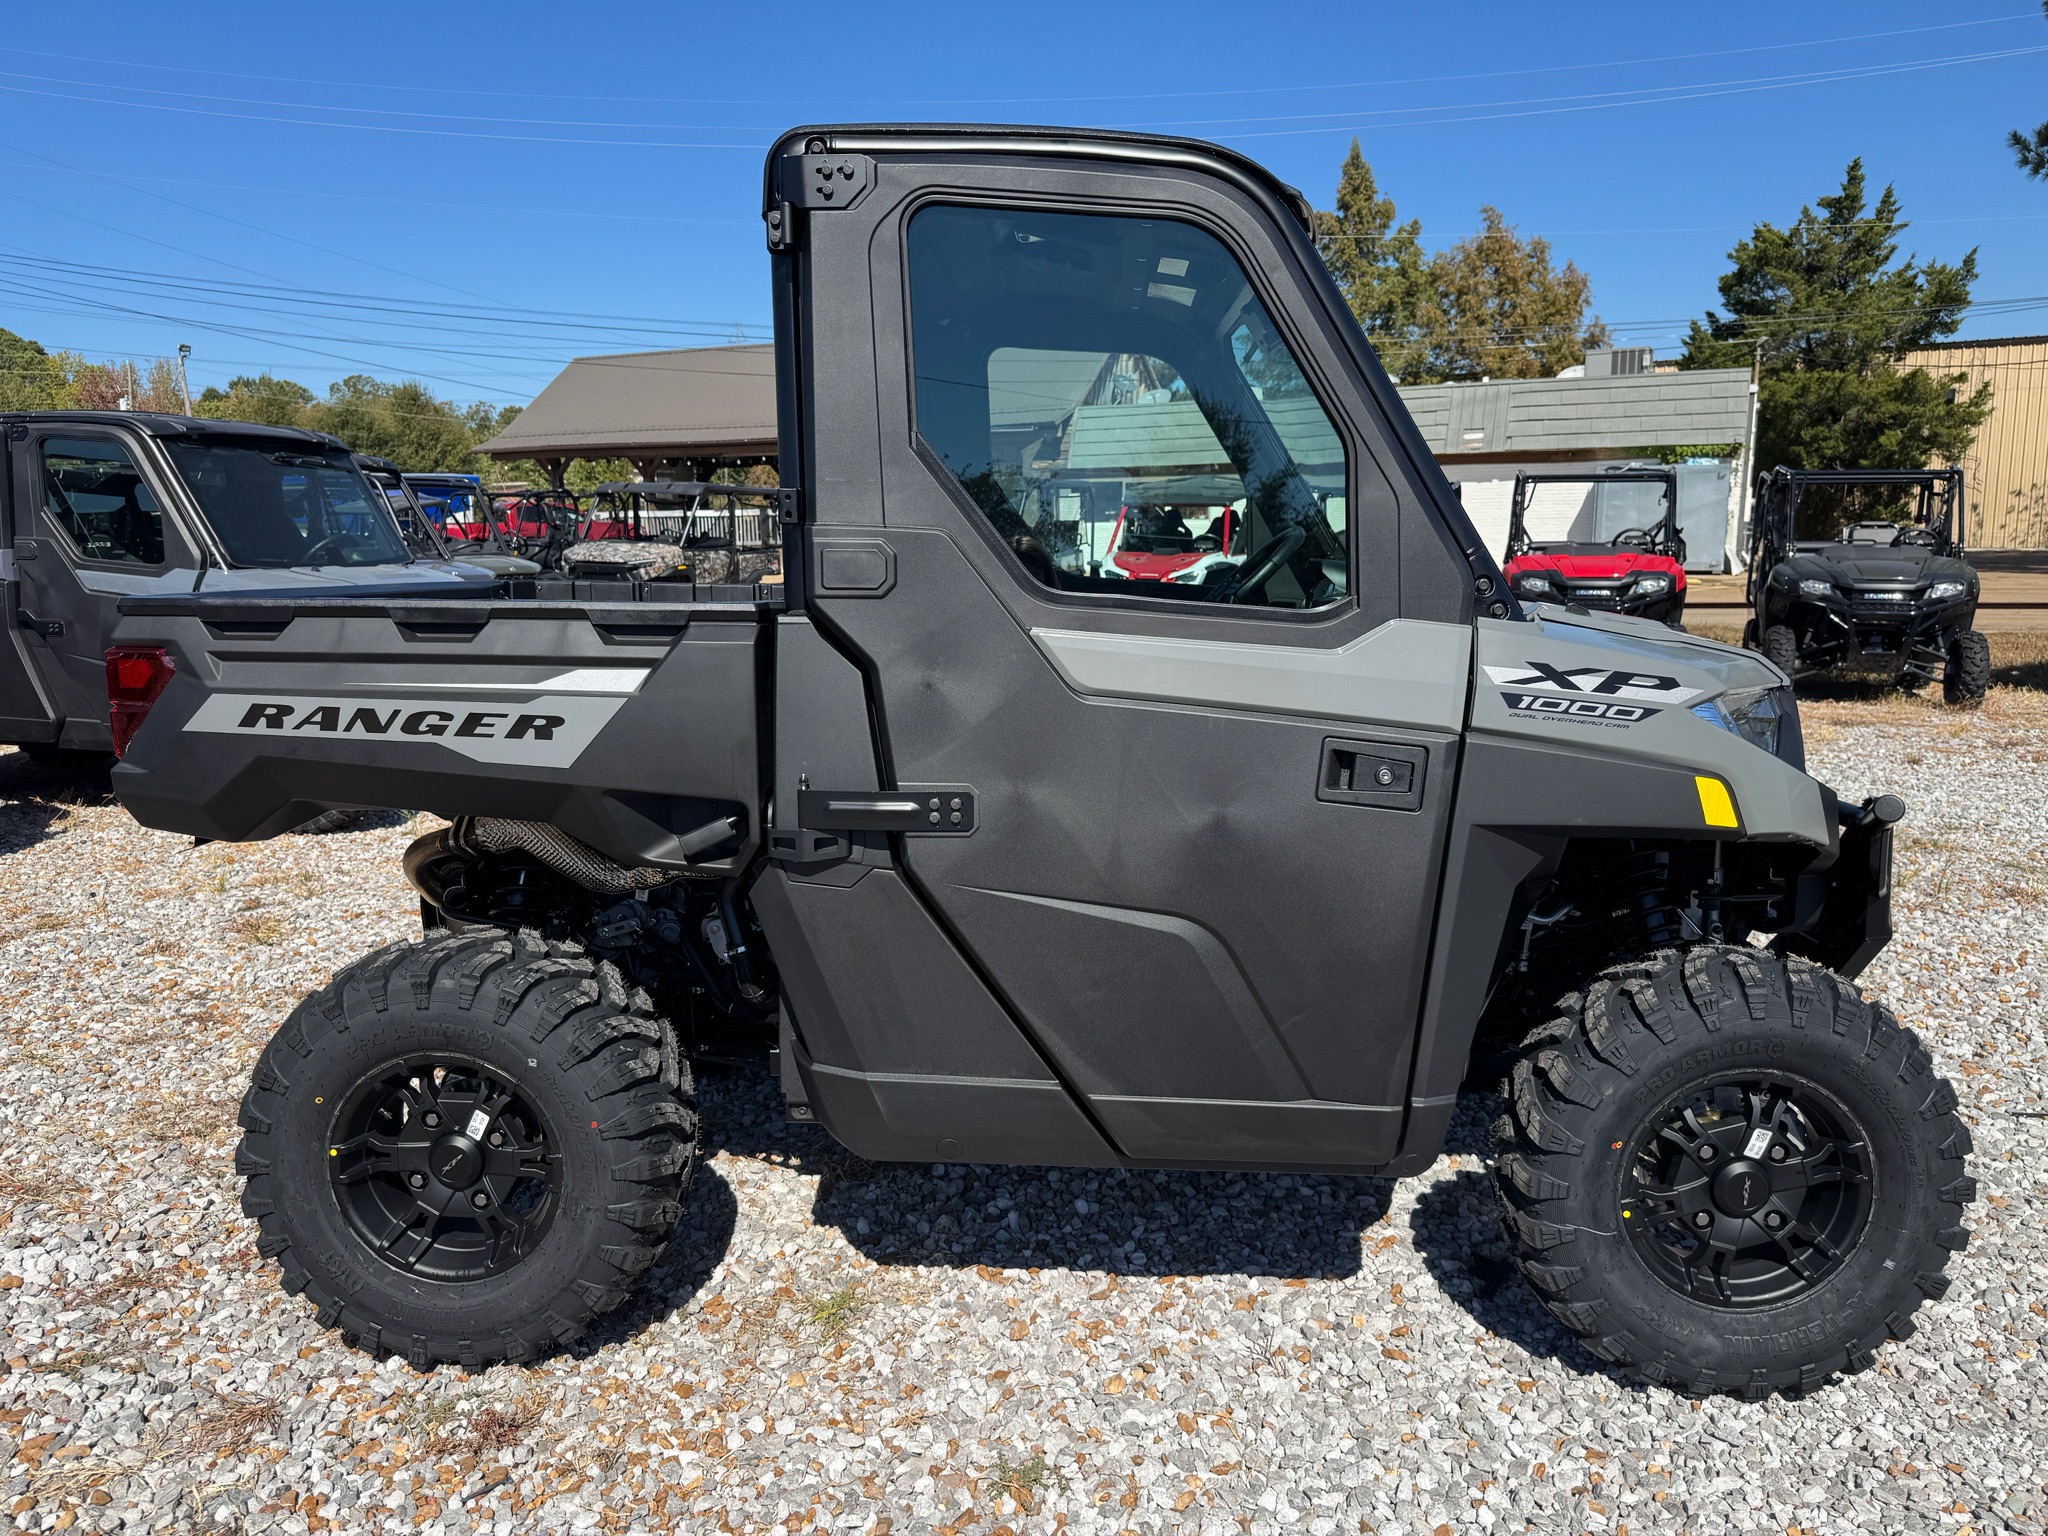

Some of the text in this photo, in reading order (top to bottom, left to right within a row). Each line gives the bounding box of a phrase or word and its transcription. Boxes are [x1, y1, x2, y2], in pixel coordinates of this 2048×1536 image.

[1500, 660, 1682, 695] XP
[237, 703, 566, 741] RANGER
[1508, 712, 1630, 730] DUAL OVERHEAD CAM
[1517, 695, 1644, 721] 1000
[1633, 1040, 1764, 1104] PRO ARMOR
[1723, 1290, 1877, 1358] X-TERRAIN
